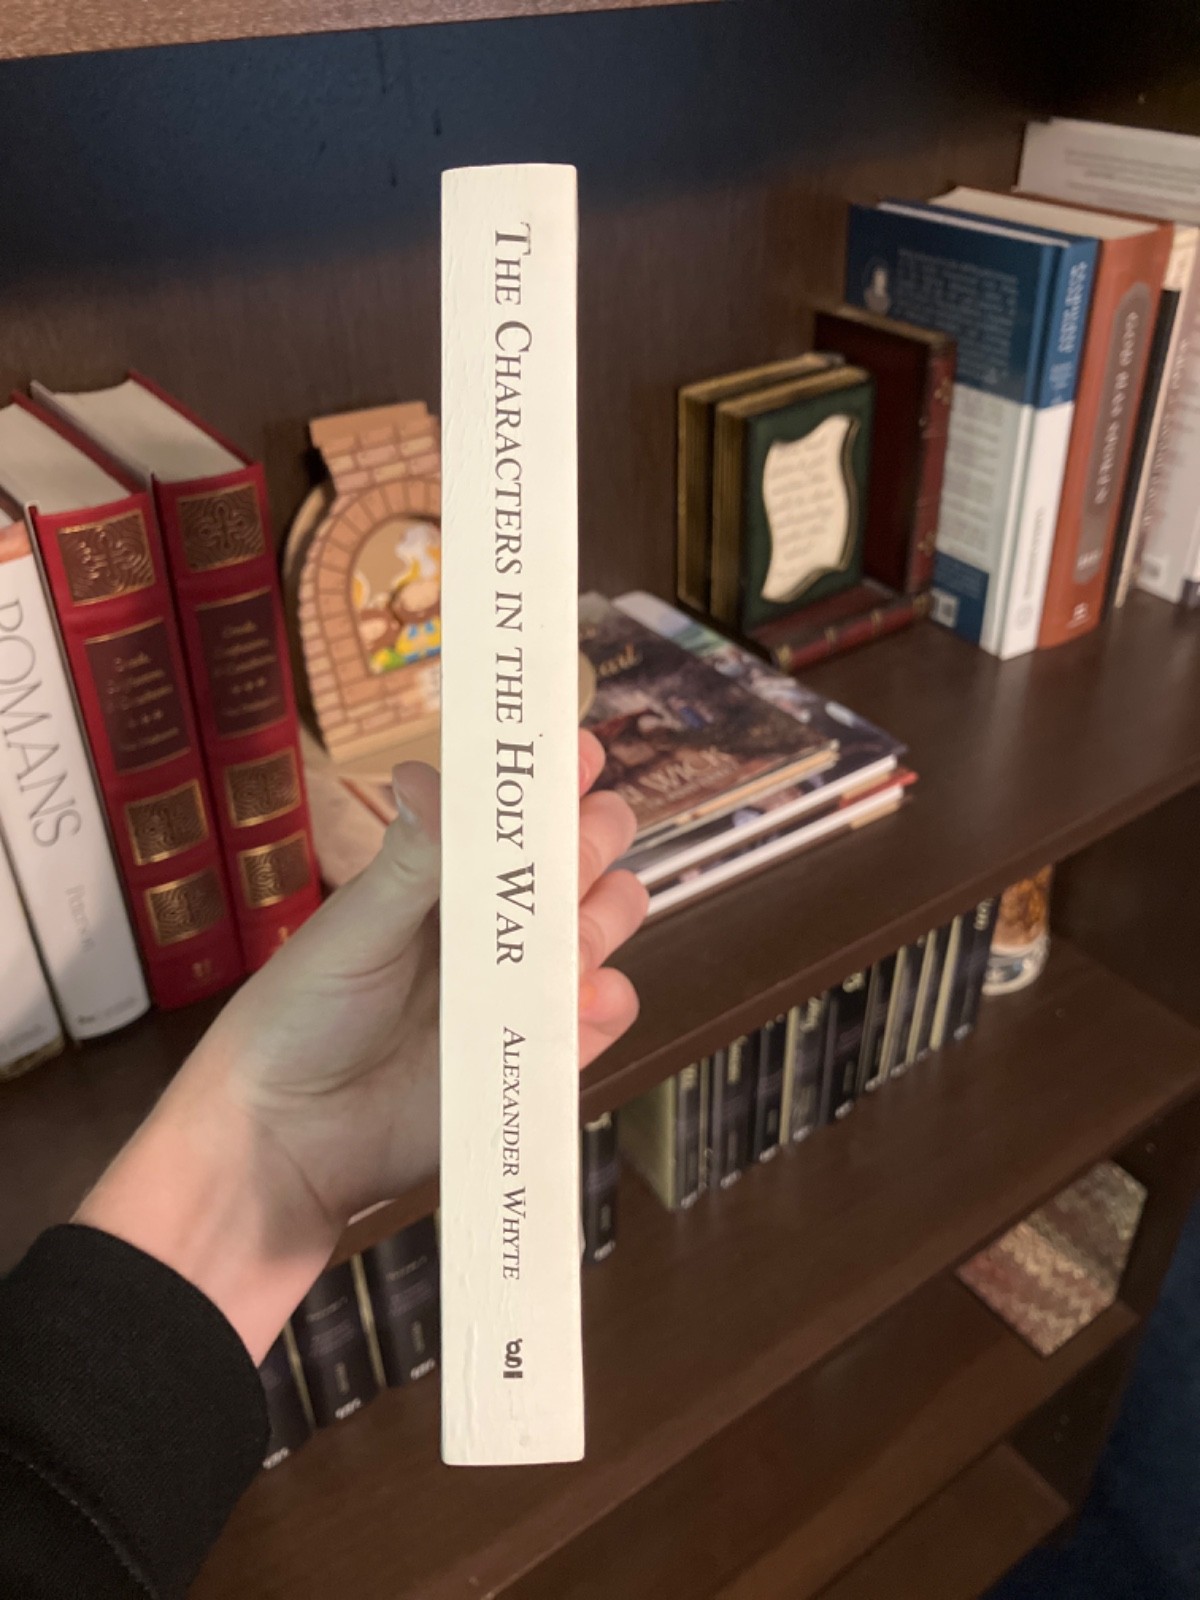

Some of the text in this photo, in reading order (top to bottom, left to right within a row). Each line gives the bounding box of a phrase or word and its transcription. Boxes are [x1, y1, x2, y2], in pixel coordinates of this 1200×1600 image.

[494, 221, 536, 965] THE CHARACTERS IN THE HOLY WAR
[502, 1026, 528, 1280] ALEXANDER WHYTE
